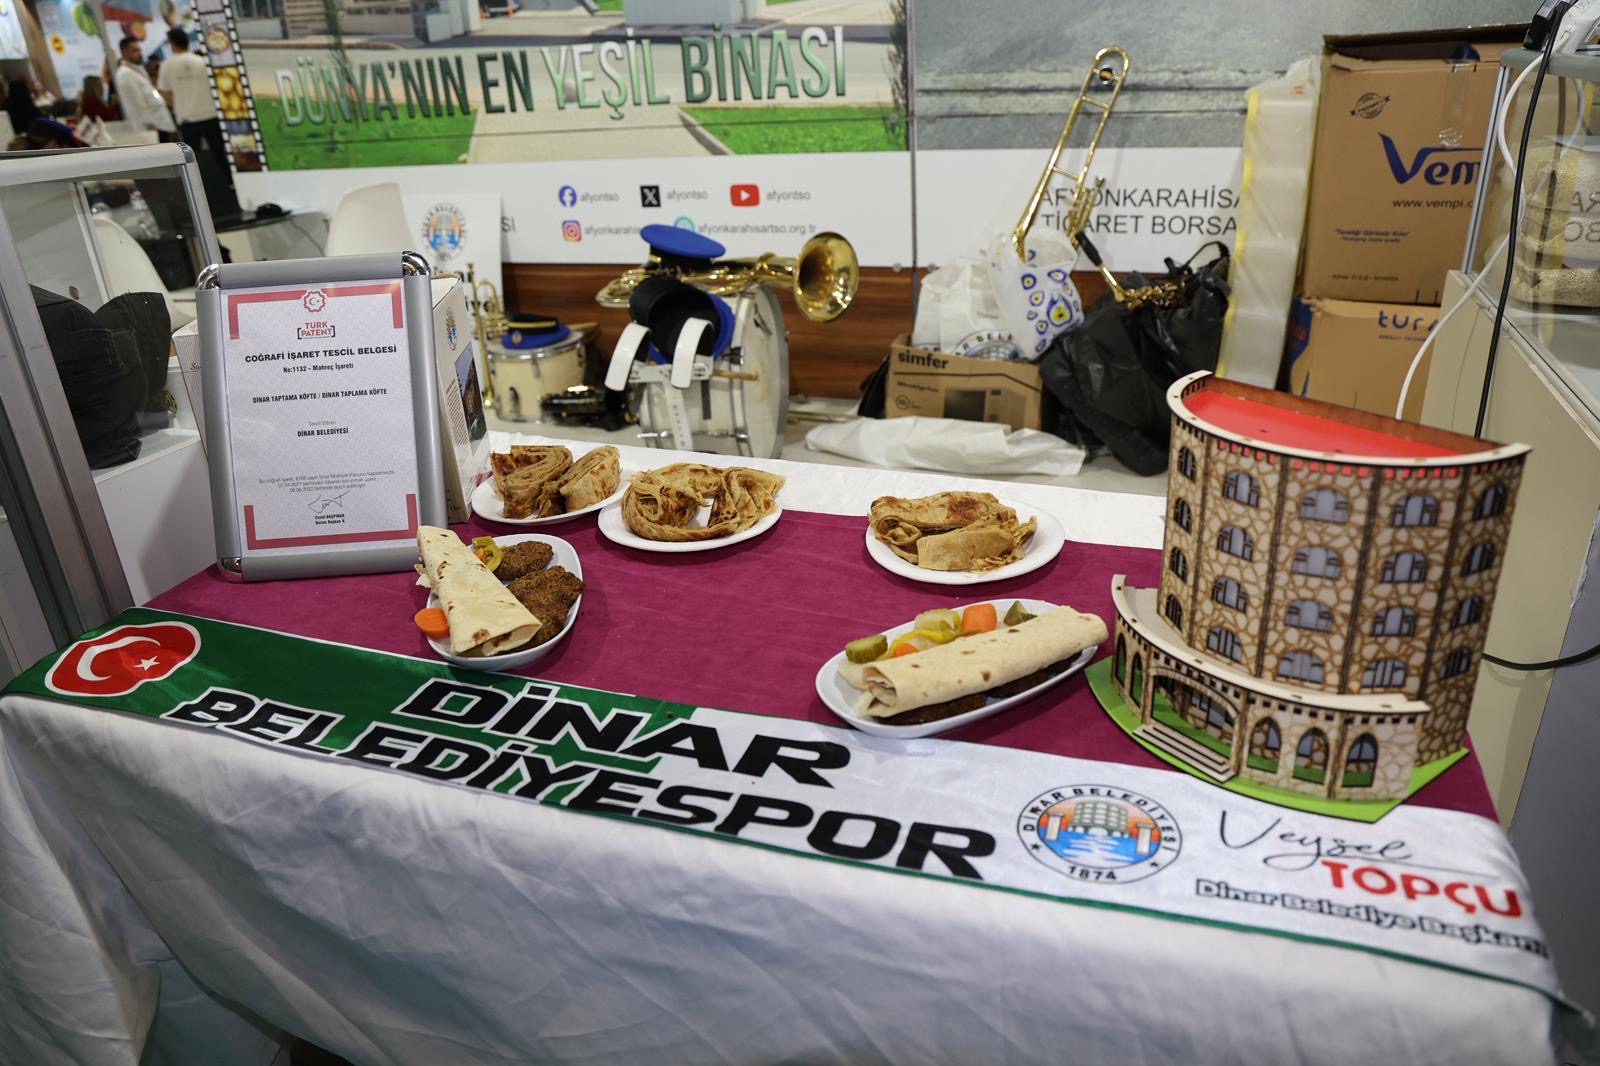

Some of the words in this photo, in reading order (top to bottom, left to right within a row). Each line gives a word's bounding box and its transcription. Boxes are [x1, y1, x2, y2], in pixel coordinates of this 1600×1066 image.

[274, 53, 471, 126] DÜNYA'NIN
[477, 50, 534, 114] EN
[540, 27, 670, 119] YEŞİL
[680, 21, 846, 103] BİNASI
[581, 191, 620, 203] afyontso
[666, 189, 708, 201] afyontso
[766, 190, 811, 202] afyontso
[245, 351, 285, 363] COĞRAFİ
[287, 349, 320, 361] İŞARET
[323, 347, 355, 357] TESCİL
[358, 344, 397, 354] BELGESİ
[898, 349, 949, 369] simfer
[297, 429, 315, 437] DİNAR
[317, 427, 348, 436] BELEDİYESİ
[392, 681, 851, 789] DİNAR
[161, 687, 996, 881] BELEDİYESPOR
[1219, 810, 1413, 872] Veysel
[1068, 865, 1117, 880] 1874
[1195, 878, 1279, 906] Dinar
[1321, 859, 1523, 918] TOPÇU
